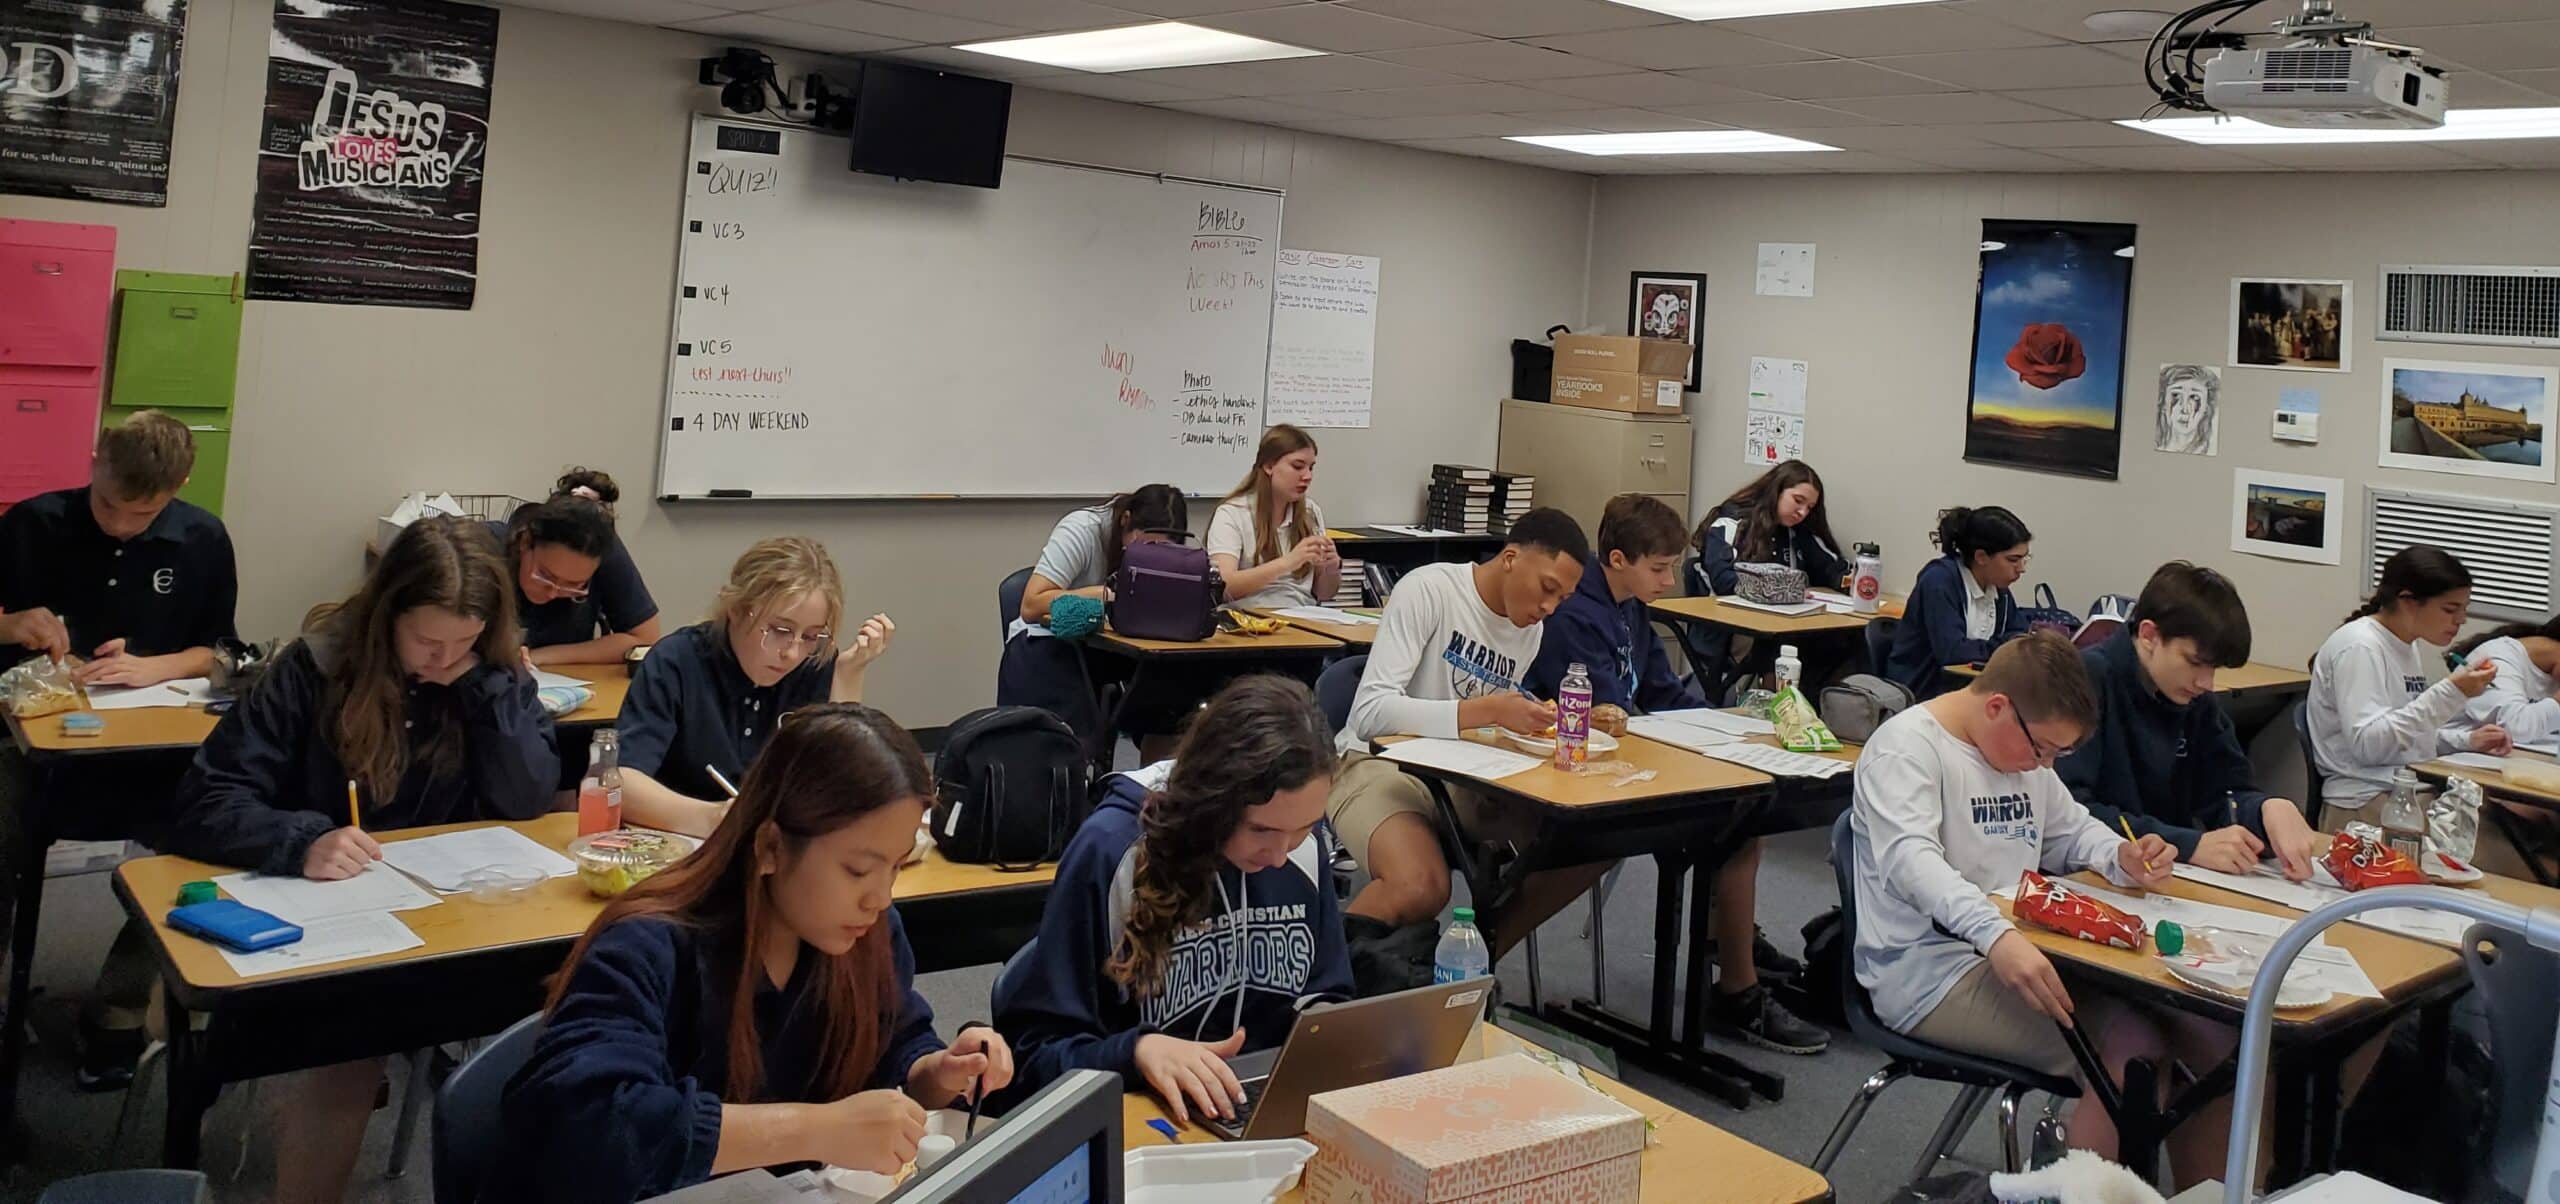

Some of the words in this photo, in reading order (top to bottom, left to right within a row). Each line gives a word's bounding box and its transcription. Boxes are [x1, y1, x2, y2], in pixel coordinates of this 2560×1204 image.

[0, 42, 79, 98] D
[2, 148, 19, 158] for
[22, 152, 39, 161] us,
[42, 151, 66, 163] who
[68, 157, 89, 165] can
[91, 156, 106, 167] be
[108, 160, 148, 173] against
[151, 163, 168, 172] us?
[335, 141, 396, 163] LOVES
[300, 149, 449, 187] MUSICIANS
[734, 223, 745, 240] 3
[704, 287, 718, 301] VC
[721, 284, 729, 305] 4
[700, 340, 716, 355] VC
[720, 340, 733, 354] 5
[693, 413, 705, 432] 4
[713, 412, 741, 431] DAY
[749, 411, 809, 431] WEEKEND
[1448, 630, 1516, 679] WARRIOR
[1217, 903, 1306, 929] CHRISTIAN
[1141, 924, 1314, 1030] WARRIORS
